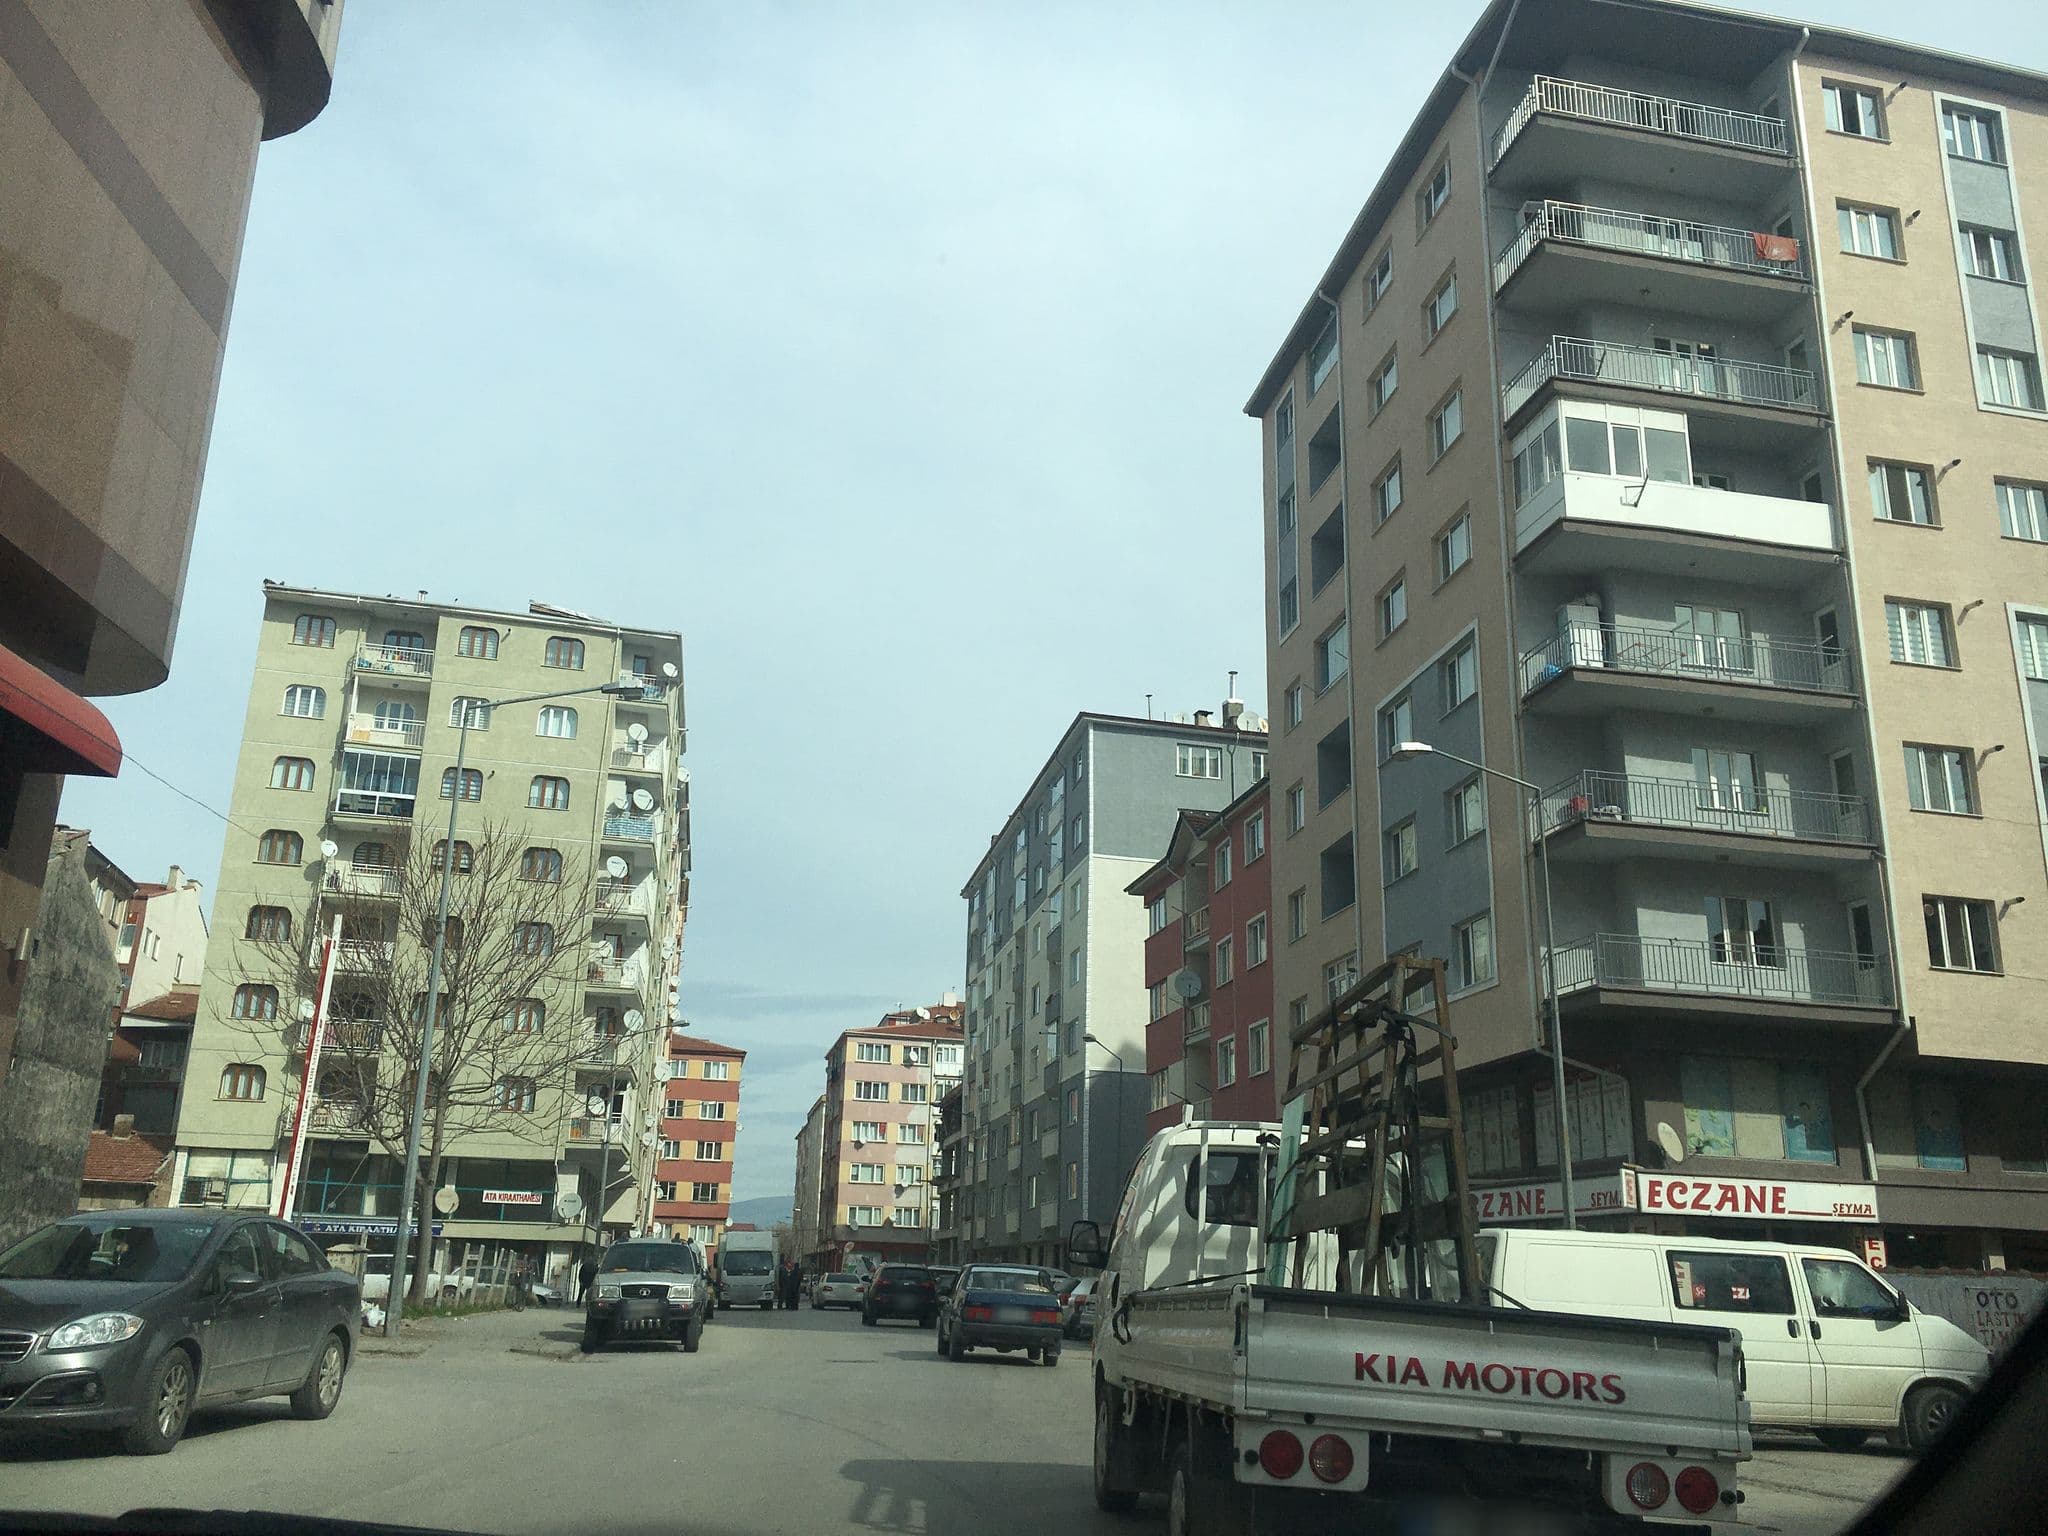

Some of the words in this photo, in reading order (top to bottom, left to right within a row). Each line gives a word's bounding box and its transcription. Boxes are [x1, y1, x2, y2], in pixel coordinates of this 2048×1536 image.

[485, 1193, 497, 1201] ATA
[1648, 1180, 1786, 1214] ECZANE
[325, 1225, 346, 1233] ATA
[1976, 1291, 2018, 1310] OTO
[1355, 1352, 1430, 1387] KIA
[1443, 1361, 1626, 1405] MOTORS
